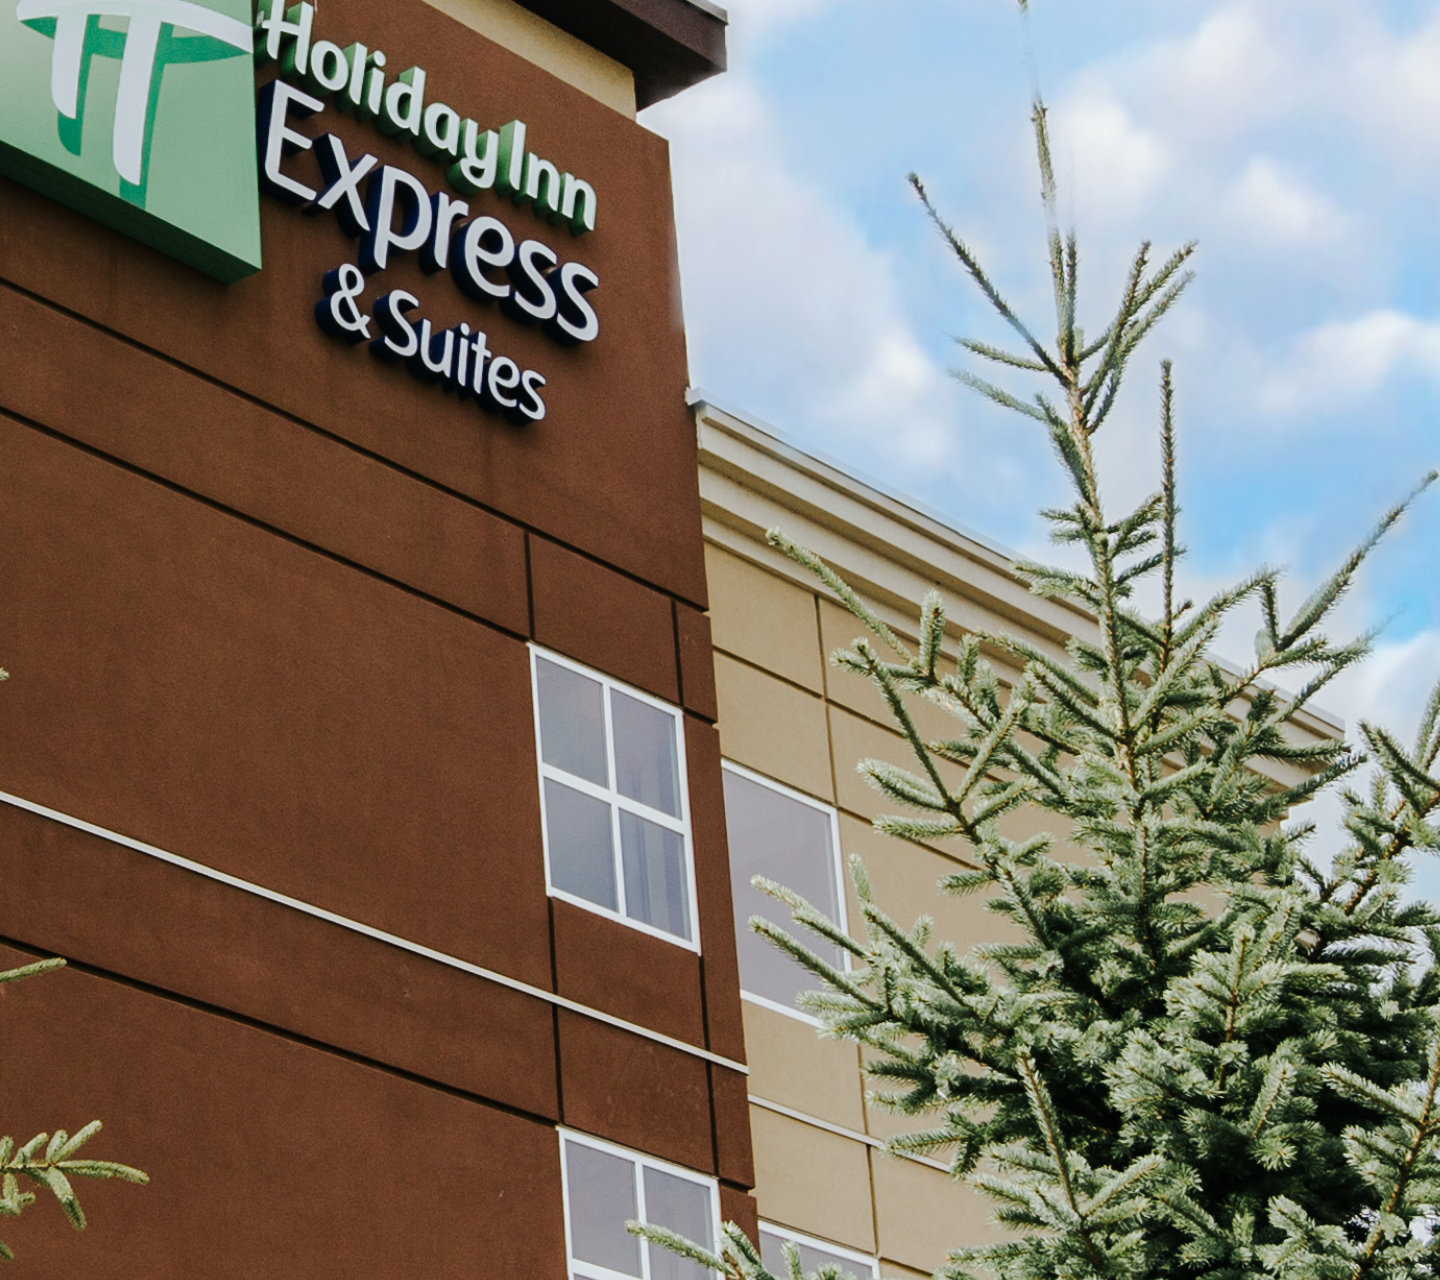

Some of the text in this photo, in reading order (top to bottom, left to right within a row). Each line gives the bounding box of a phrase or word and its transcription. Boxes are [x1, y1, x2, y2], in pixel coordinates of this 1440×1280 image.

[264, 79, 600, 342] Express
[507, 119, 598, 232] Inn
[328, 263, 547, 421] & Suites
